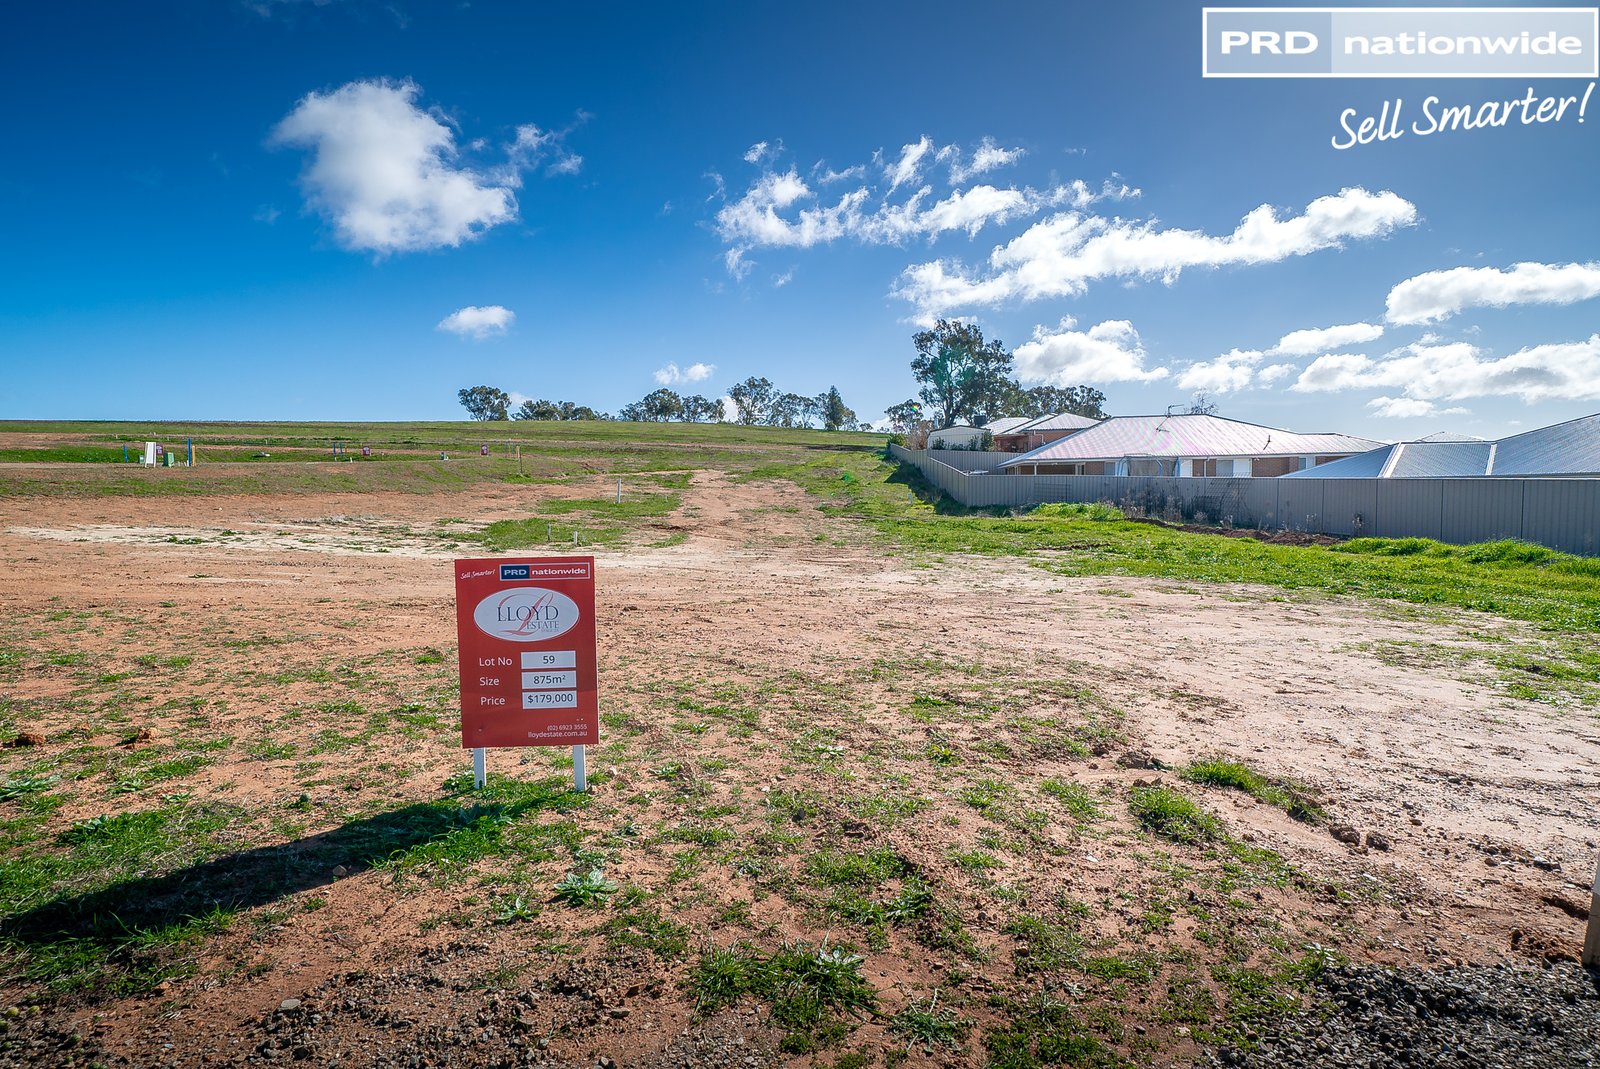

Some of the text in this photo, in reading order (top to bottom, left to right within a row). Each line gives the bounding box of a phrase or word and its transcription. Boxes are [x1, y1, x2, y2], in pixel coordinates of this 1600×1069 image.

[497, 605, 559, 621] LLOYD
[526, 621, 560, 630] ESTATE
[479, 655, 555, 667] Lot No 59
[479, 677, 500, 687] Size
[480, 693, 574, 706] Price $179,000
[528, 731, 588, 739] lloydestate.com.au
